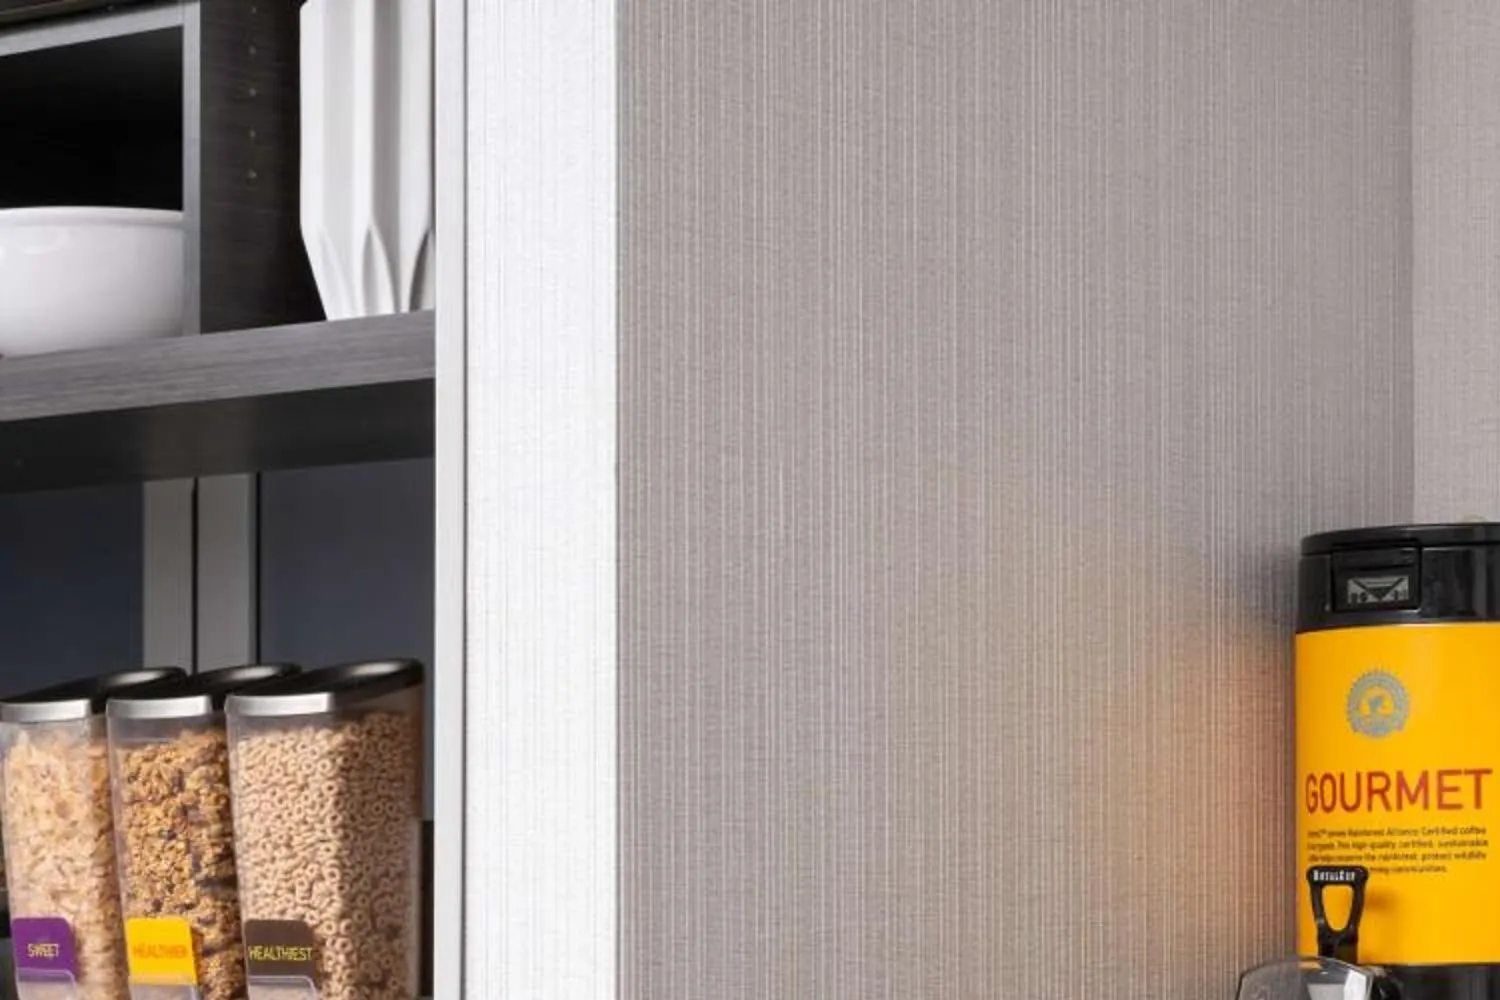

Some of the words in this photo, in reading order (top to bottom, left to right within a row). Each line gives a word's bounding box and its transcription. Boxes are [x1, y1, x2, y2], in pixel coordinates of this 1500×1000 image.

[1305, 768, 1493, 815] GOURMET
[26, 943, 59, 958] SWEET
[247, 944, 313, 961] HEALTHIEST
